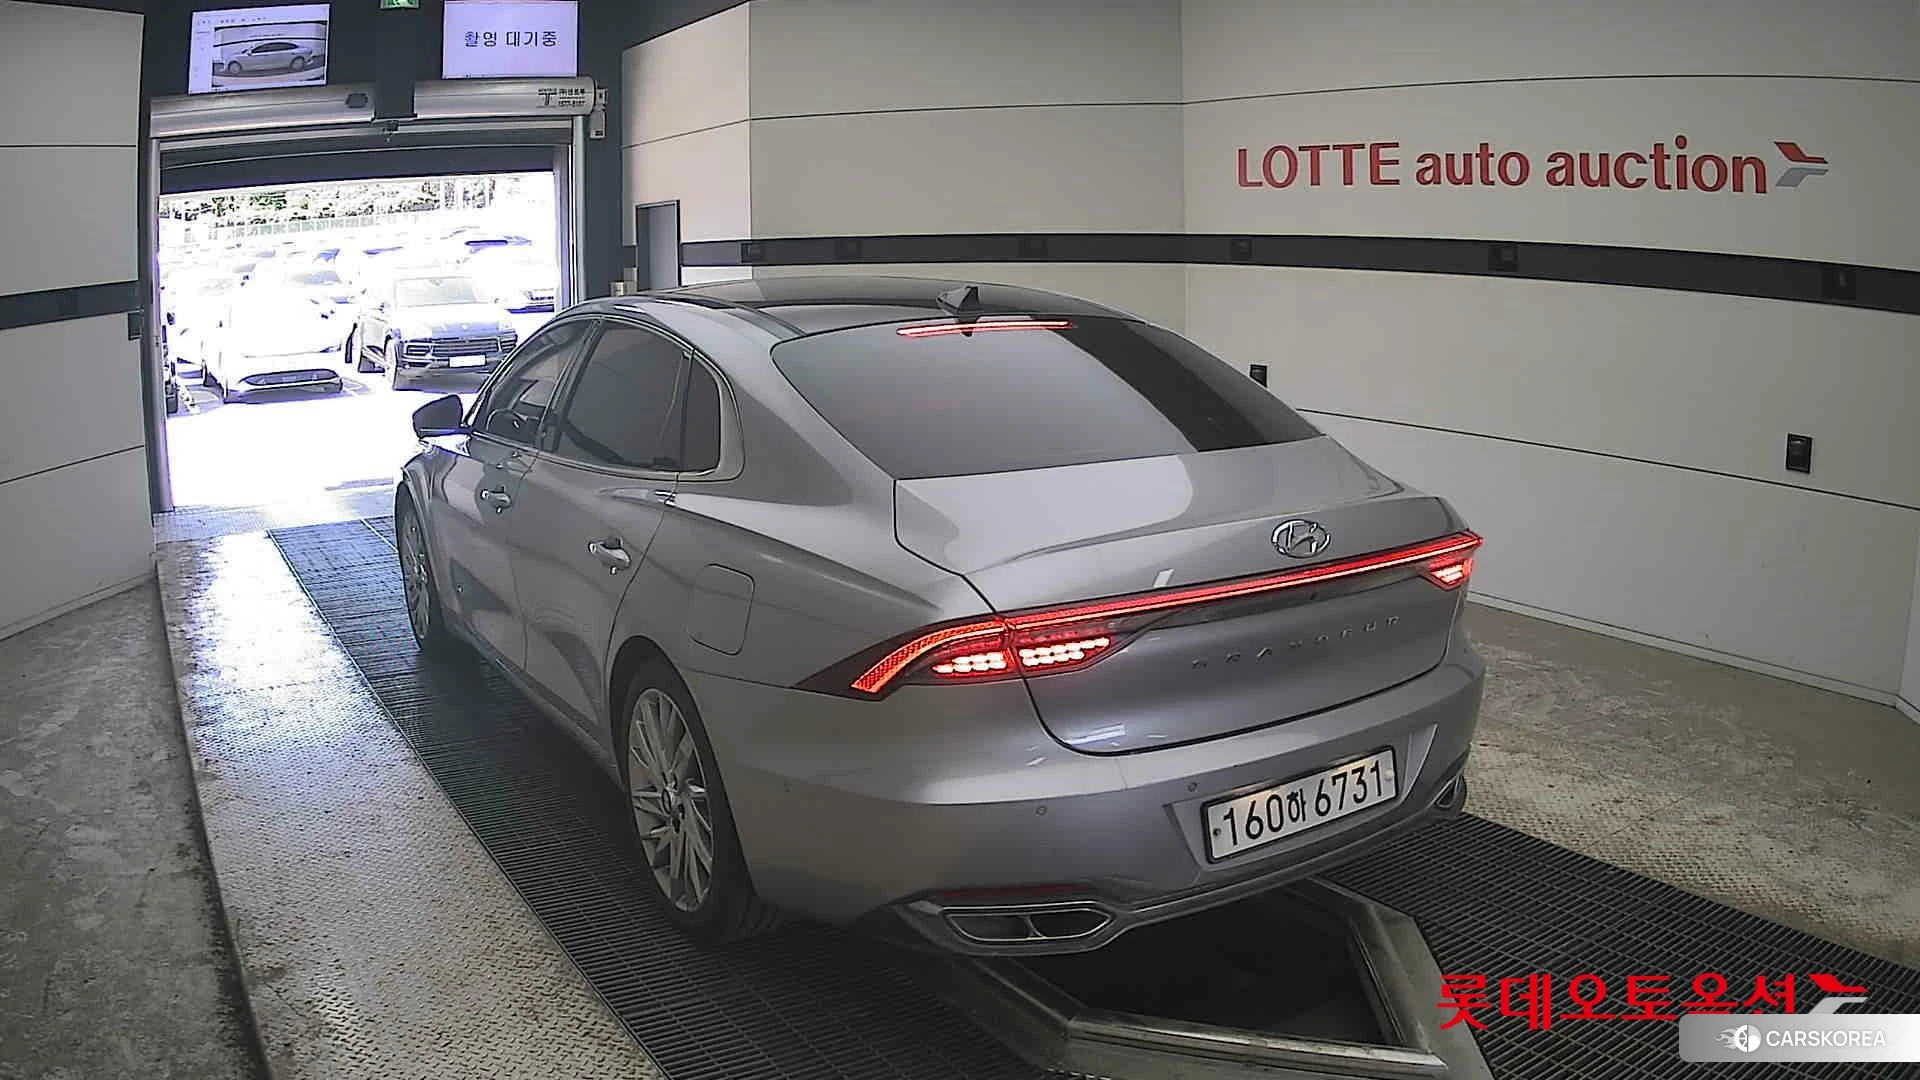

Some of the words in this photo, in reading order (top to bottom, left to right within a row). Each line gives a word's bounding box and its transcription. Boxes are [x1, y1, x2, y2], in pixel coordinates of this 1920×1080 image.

[464, 31, 497, 47] 촬영
[505, 31, 558, 47] 대기중
[1237, 142, 1401, 188] LOTTE
[1415, 142, 1531, 186] auto
[1545, 134, 1768, 194] auction
